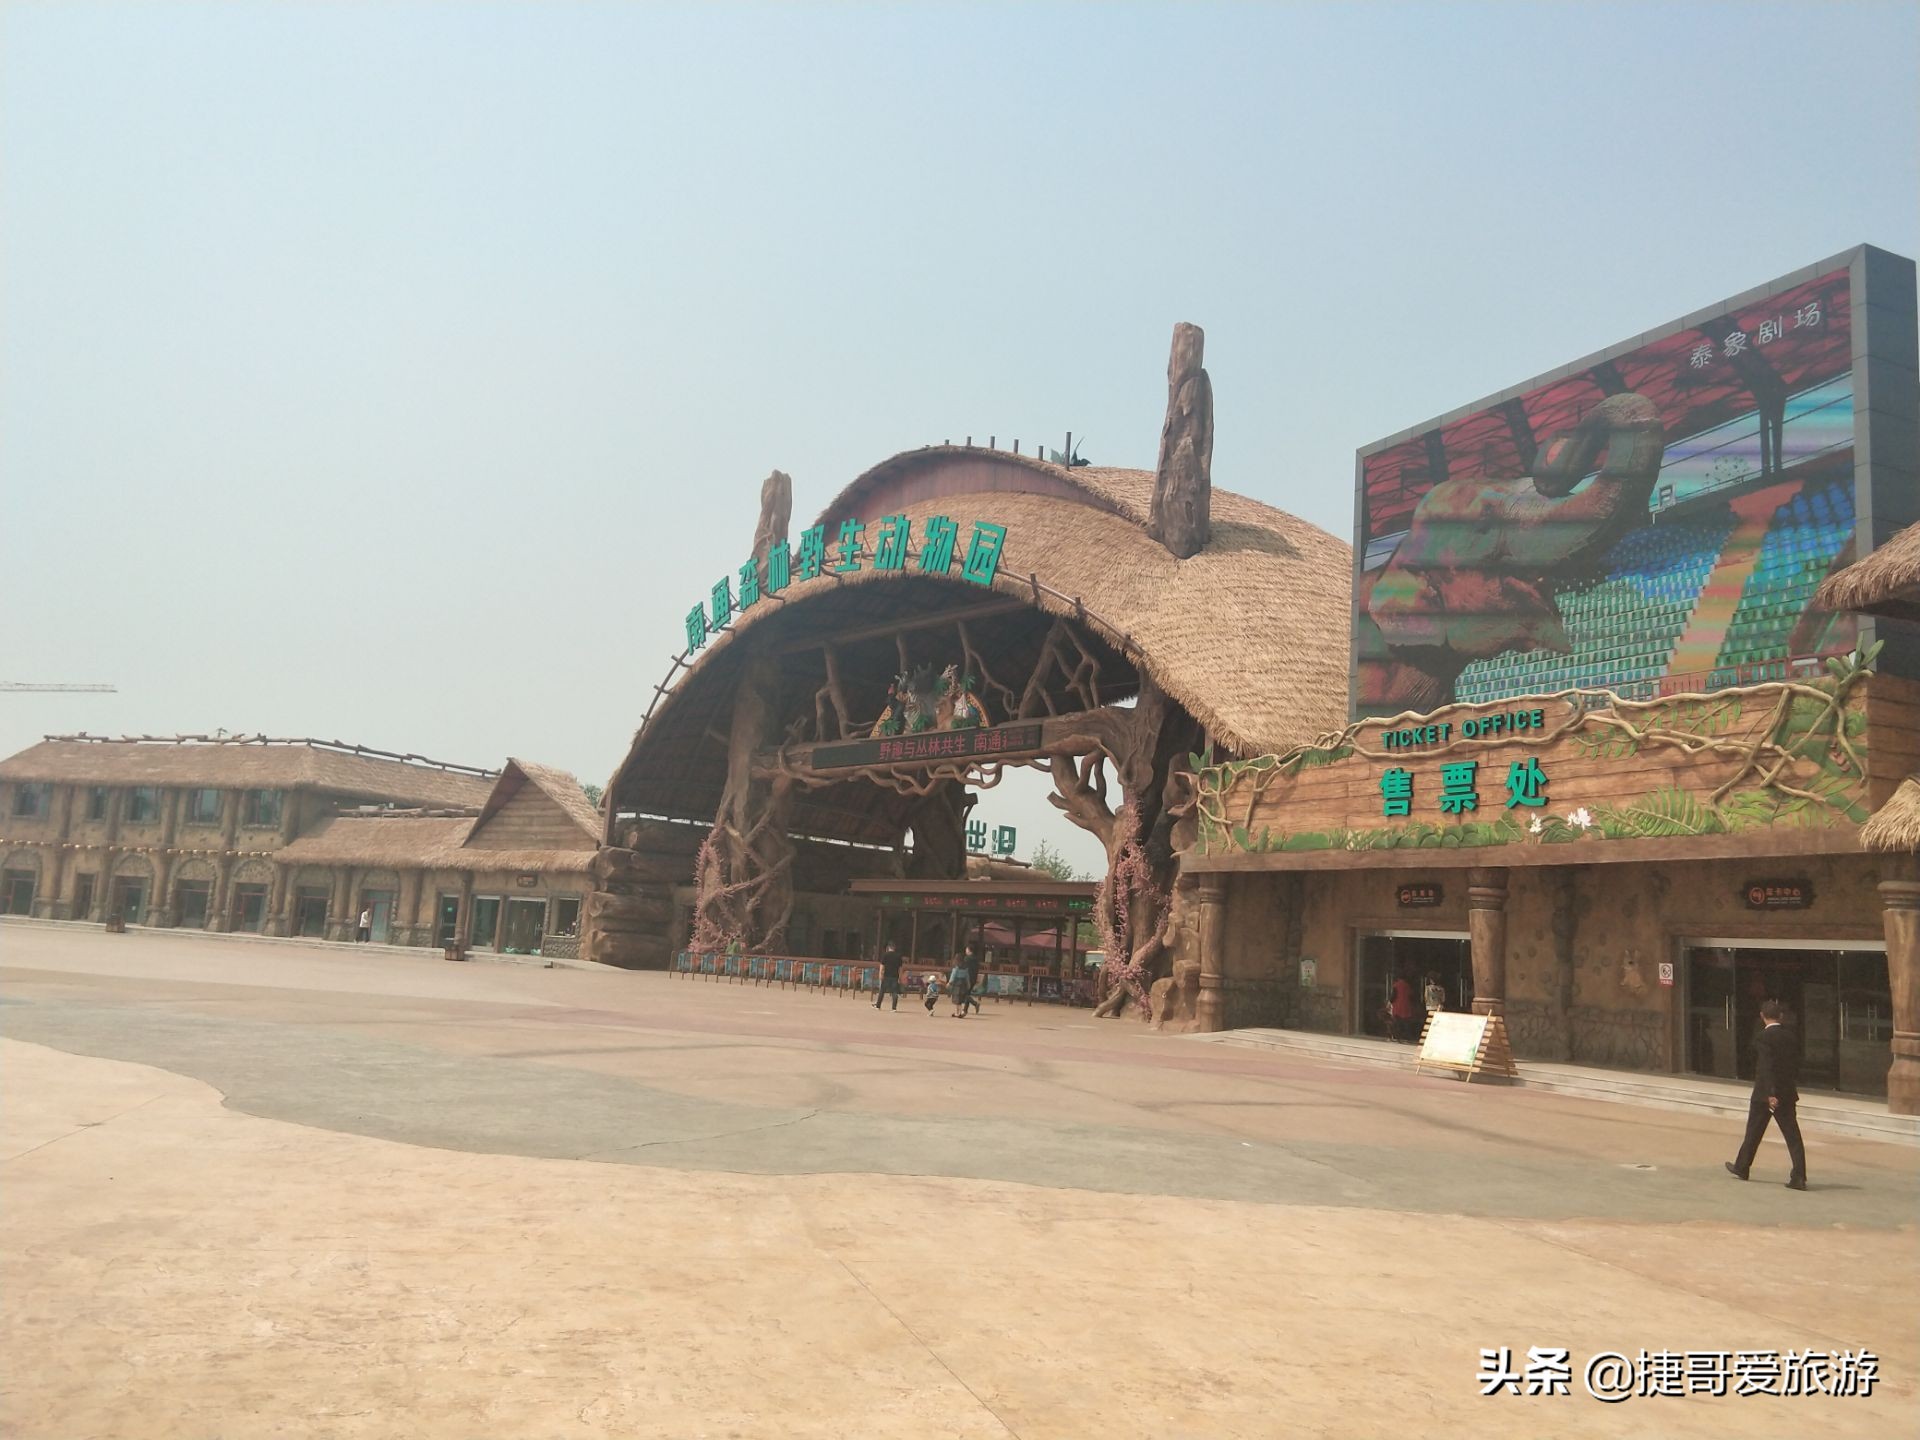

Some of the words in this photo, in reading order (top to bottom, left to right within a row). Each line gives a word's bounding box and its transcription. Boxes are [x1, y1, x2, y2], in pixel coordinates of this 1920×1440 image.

[1689, 302, 1822, 370] 泰象剧场
[685, 513, 1008, 656] 南通森林野生动物园
[879, 733, 966, 761] 野趣与丛林共生
[1381, 723, 1452, 750] TICKET
[1461, 708, 1545, 738] OFFICE
[1378, 756, 1550, 818] 售票处
